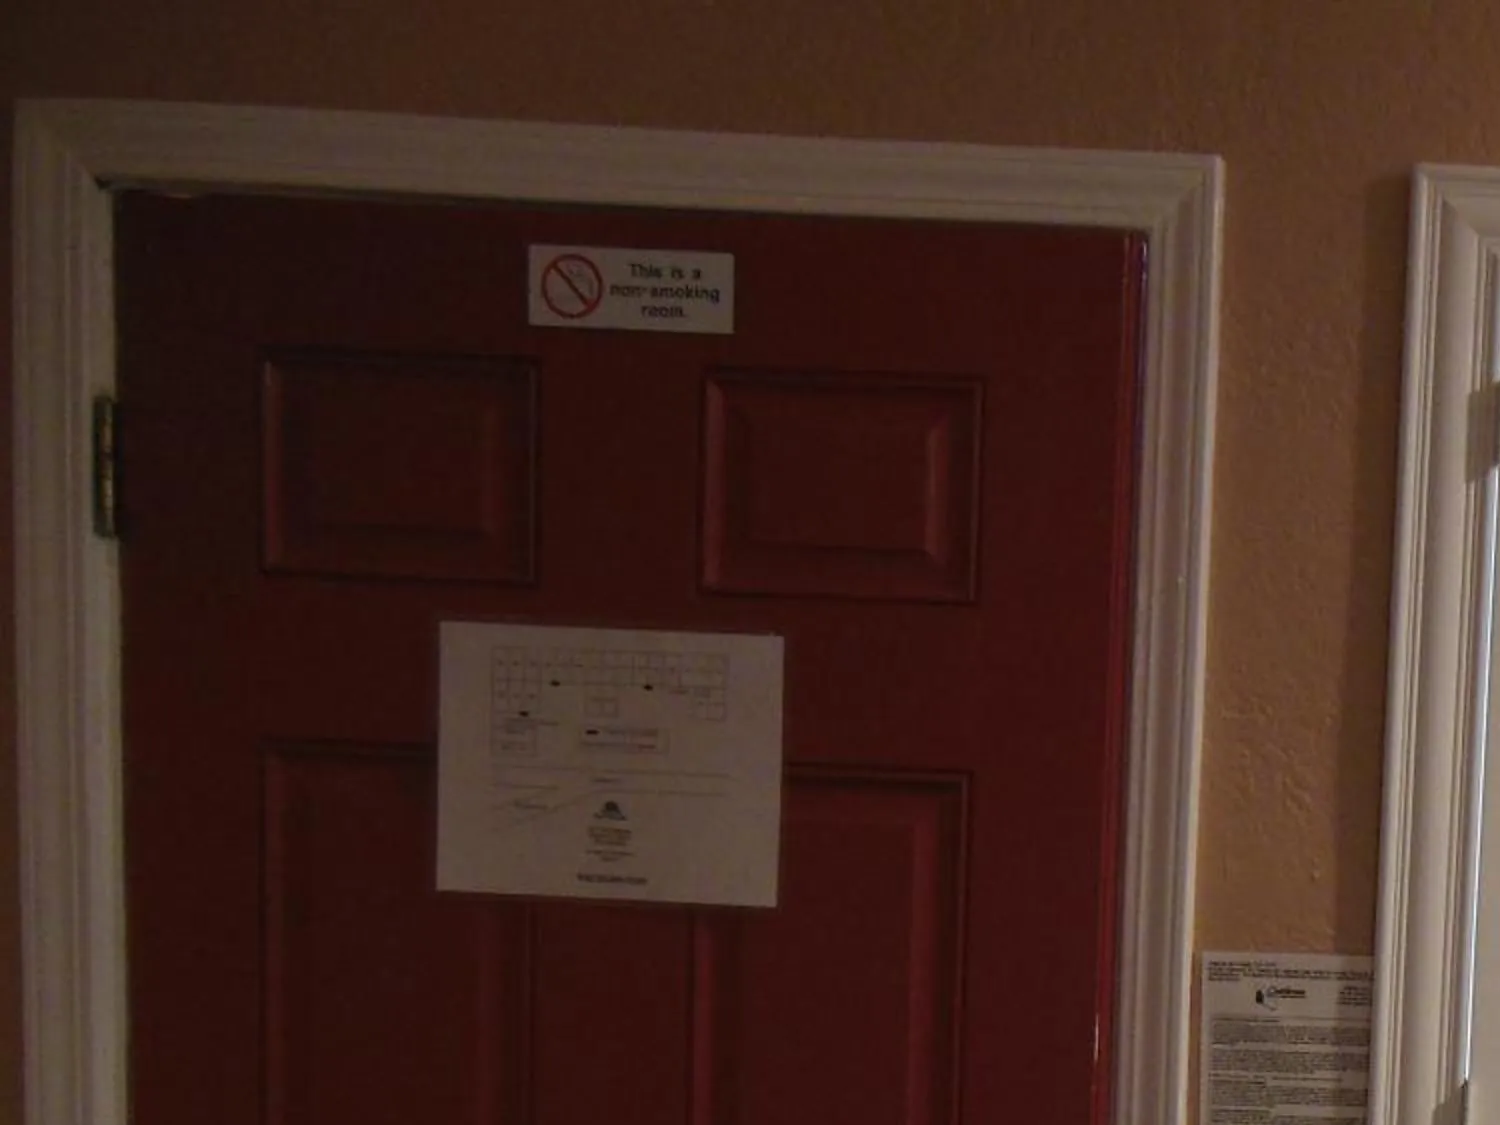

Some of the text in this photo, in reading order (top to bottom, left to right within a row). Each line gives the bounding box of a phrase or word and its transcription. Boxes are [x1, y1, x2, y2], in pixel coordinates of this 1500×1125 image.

[629, 263, 702, 279] This is a
